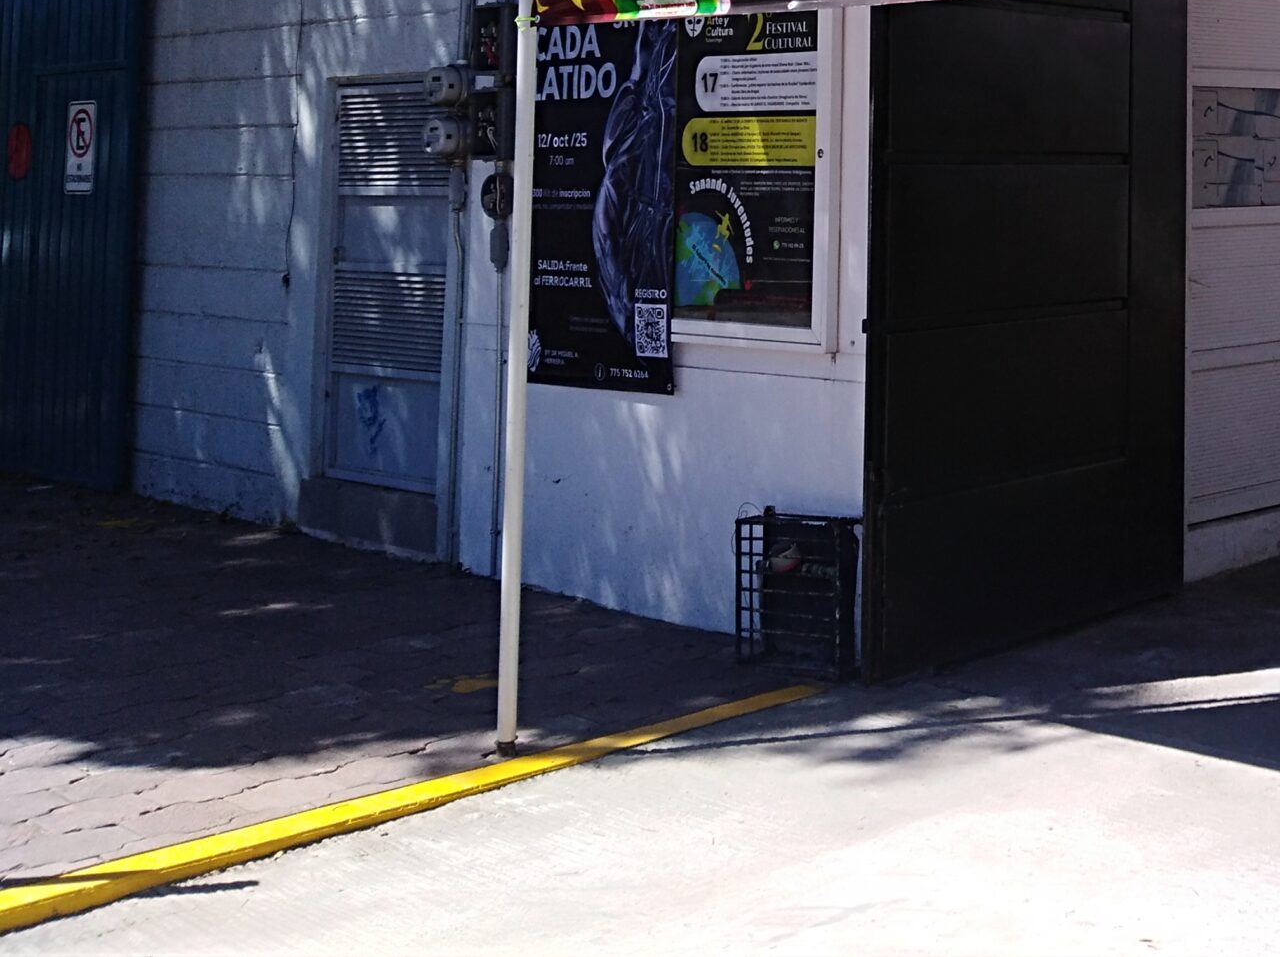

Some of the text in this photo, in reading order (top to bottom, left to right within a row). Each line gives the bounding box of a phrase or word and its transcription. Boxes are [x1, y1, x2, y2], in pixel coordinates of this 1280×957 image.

[706, 17, 724, 26] Arte
[766, 21, 809, 35] FESTIVAL
[705, 27, 734, 37] Cultura
[536, 24, 601, 61] CADA
[764, 36, 814, 50] CULTURAL
[701, 72, 719, 93] 17
[552, 135, 568, 147] oct
[691, 132, 709, 153] 18
[689, 178, 727, 195] Sanando
[542, 277, 592, 288] FERROCARRIL
[635, 289, 667, 299] REGISTRO
[610, 367, 621, 377] 775
[621, 368, 633, 378] 752
